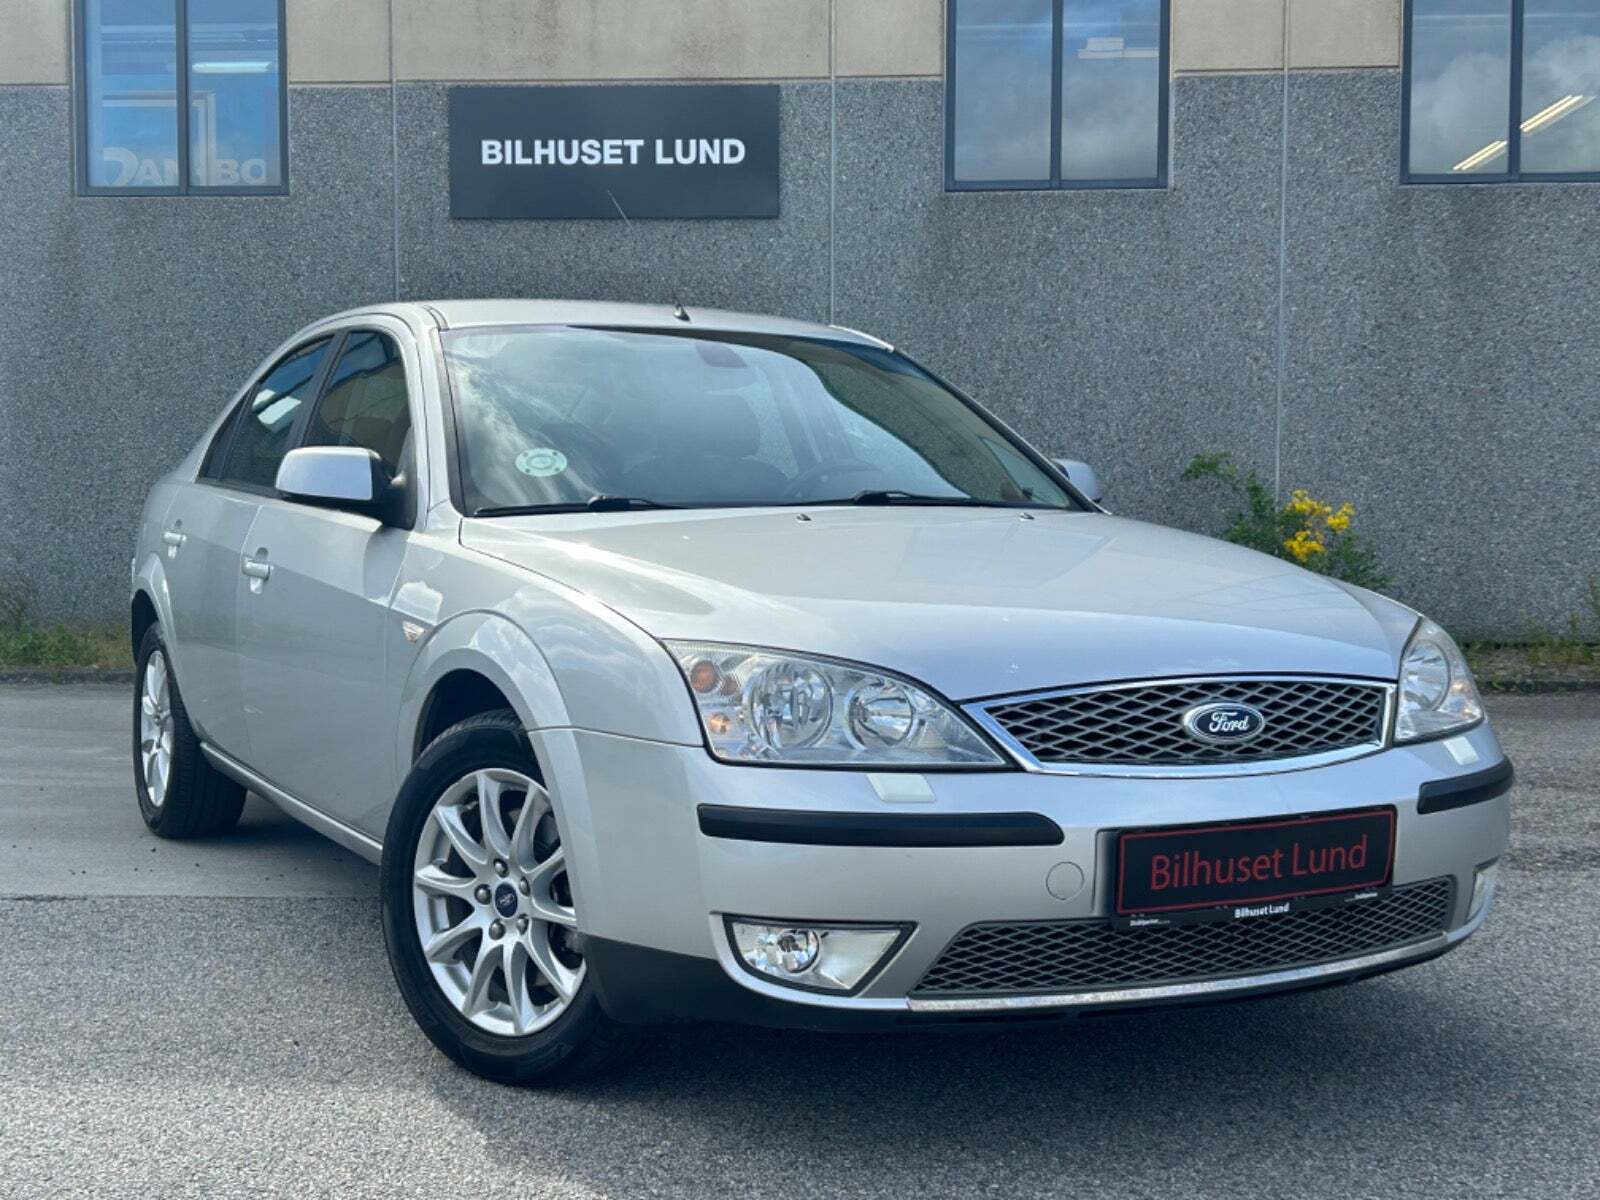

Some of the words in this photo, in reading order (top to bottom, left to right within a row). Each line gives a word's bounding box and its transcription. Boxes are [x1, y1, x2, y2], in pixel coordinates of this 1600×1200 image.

[481, 138, 645, 165] BILHUSET
[655, 138, 746, 165] LUND
[1208, 711, 1250, 732] Ford
[1150, 850, 1284, 890] Bilhuset
[1290, 833, 1368, 876] Lund
[1234, 906, 1268, 918] Bilhuset
[1269, 902, 1290, 914] Lund
